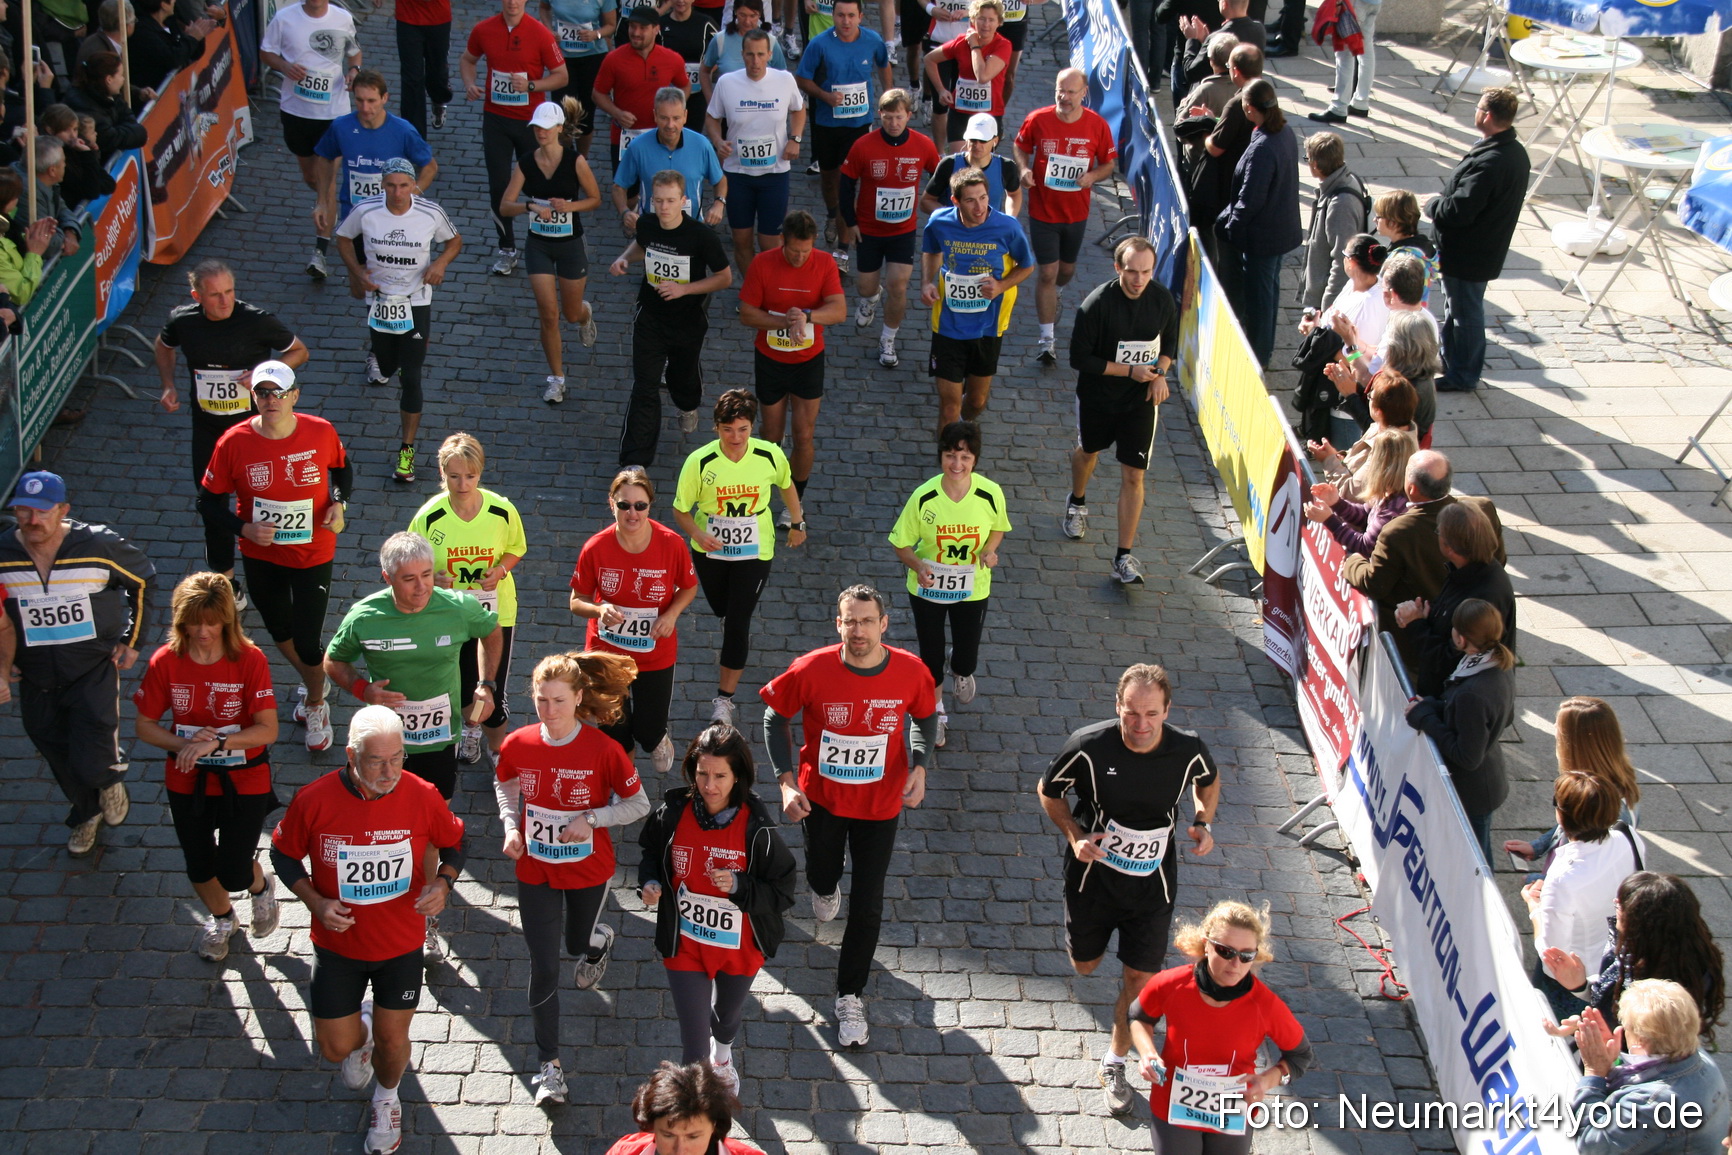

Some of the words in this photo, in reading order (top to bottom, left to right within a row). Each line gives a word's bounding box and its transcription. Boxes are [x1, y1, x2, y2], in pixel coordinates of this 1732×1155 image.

[841, 92, 866, 106] 536
[960, 87, 987, 100] 2969
[742, 143, 772, 158] 3187
[354, 181, 384, 196] 245
[1055, 178, 1075, 187] Bernd
[881, 197, 911, 210] 2177
[882, 210, 909, 219] Michael
[540, 224, 562, 233] Nadja
[371, 237, 422, 248] CharityCycling.de
[952, 241, 997, 250] NEUMARKTER
[950, 247, 988, 255] STADTLAUF
[376, 253, 418, 265] WÖHRL
[654, 261, 680, 278] 293
[951, 299, 986, 308] Christian
[374, 304, 407, 320] 3093
[1122, 348, 1156, 363] 2465
[206, 382, 239, 399] 758
[209, 399, 240, 410] Philipp
[251, 475, 269, 483] NEU
[716, 484, 760, 495] Müller
[726, 502, 748, 517] M
[260, 510, 306, 530] 2222
[936, 524, 980, 534] Müller
[447, 546, 494, 557] Müller
[723, 545, 742, 555] Rita
[946, 545, 970, 560] M
[459, 567, 483, 584] M
[922, 588, 967, 599] Rosmarie
[28, 603, 85, 627] 3566
[1309, 585, 1349, 660] VERKAU
[606, 632, 648, 647] Manuela
[404, 729, 441, 740] ndreas
[827, 746, 879, 765] 2187
[828, 765, 875, 777] Dominik
[324, 850, 337, 858] NE
[538, 842, 579, 859] Brigitte
[710, 847, 746, 857] NEUMARKTER
[1108, 835, 1160, 860] 2429
[709, 852, 739, 860] STADTLAUF
[1106, 851, 1156, 870] Siegfried
[346, 858, 404, 883] 2807
[354, 882, 398, 897] Helmut
[680, 900, 733, 930] 2806
[692, 923, 717, 940] Elke
[1184, 1076, 1216, 1087] PFLEIDERER
[1186, 1107, 1230, 1126] Sabine
